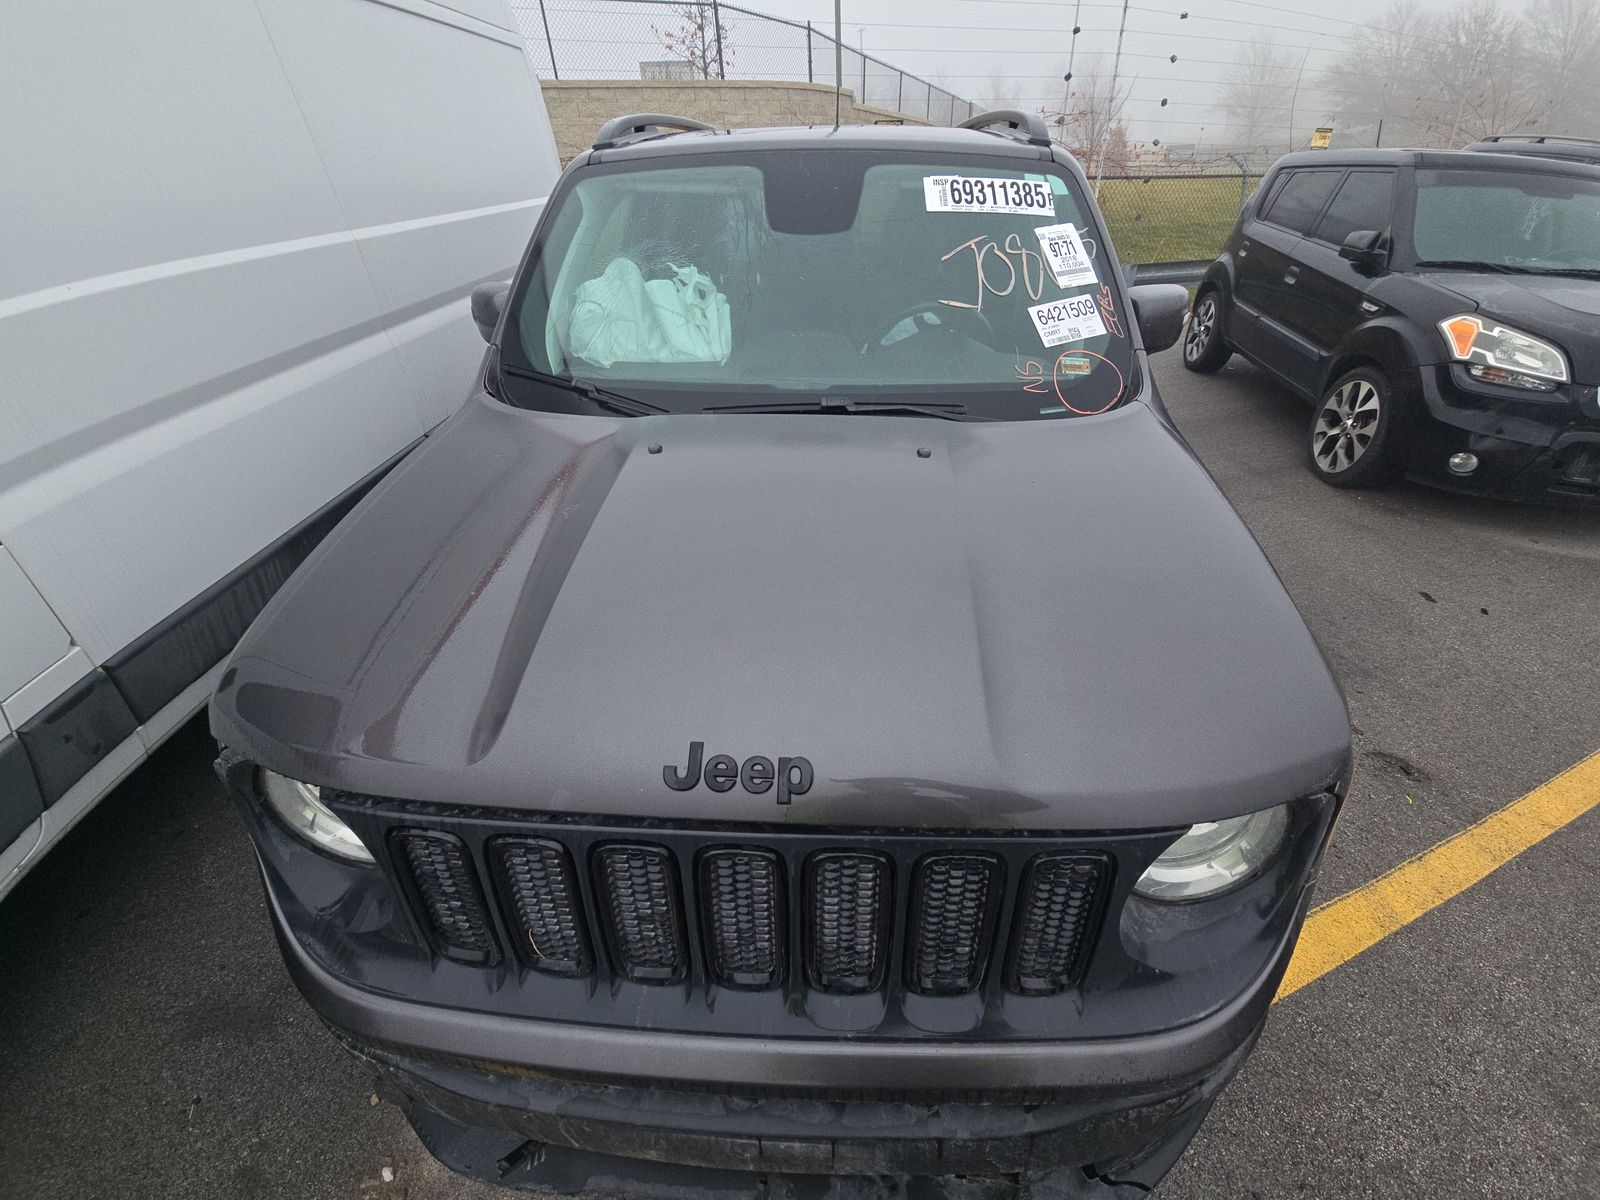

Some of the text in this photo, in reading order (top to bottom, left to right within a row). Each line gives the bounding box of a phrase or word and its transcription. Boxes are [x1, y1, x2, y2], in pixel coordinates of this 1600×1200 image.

[932, 178, 949, 186] INSP
[950, 178, 1047, 208] 69311385
[1060, 255, 1077, 263] 2018
[1037, 299, 1095, 325] 6421509
[662, 741, 814, 805] Jeep
